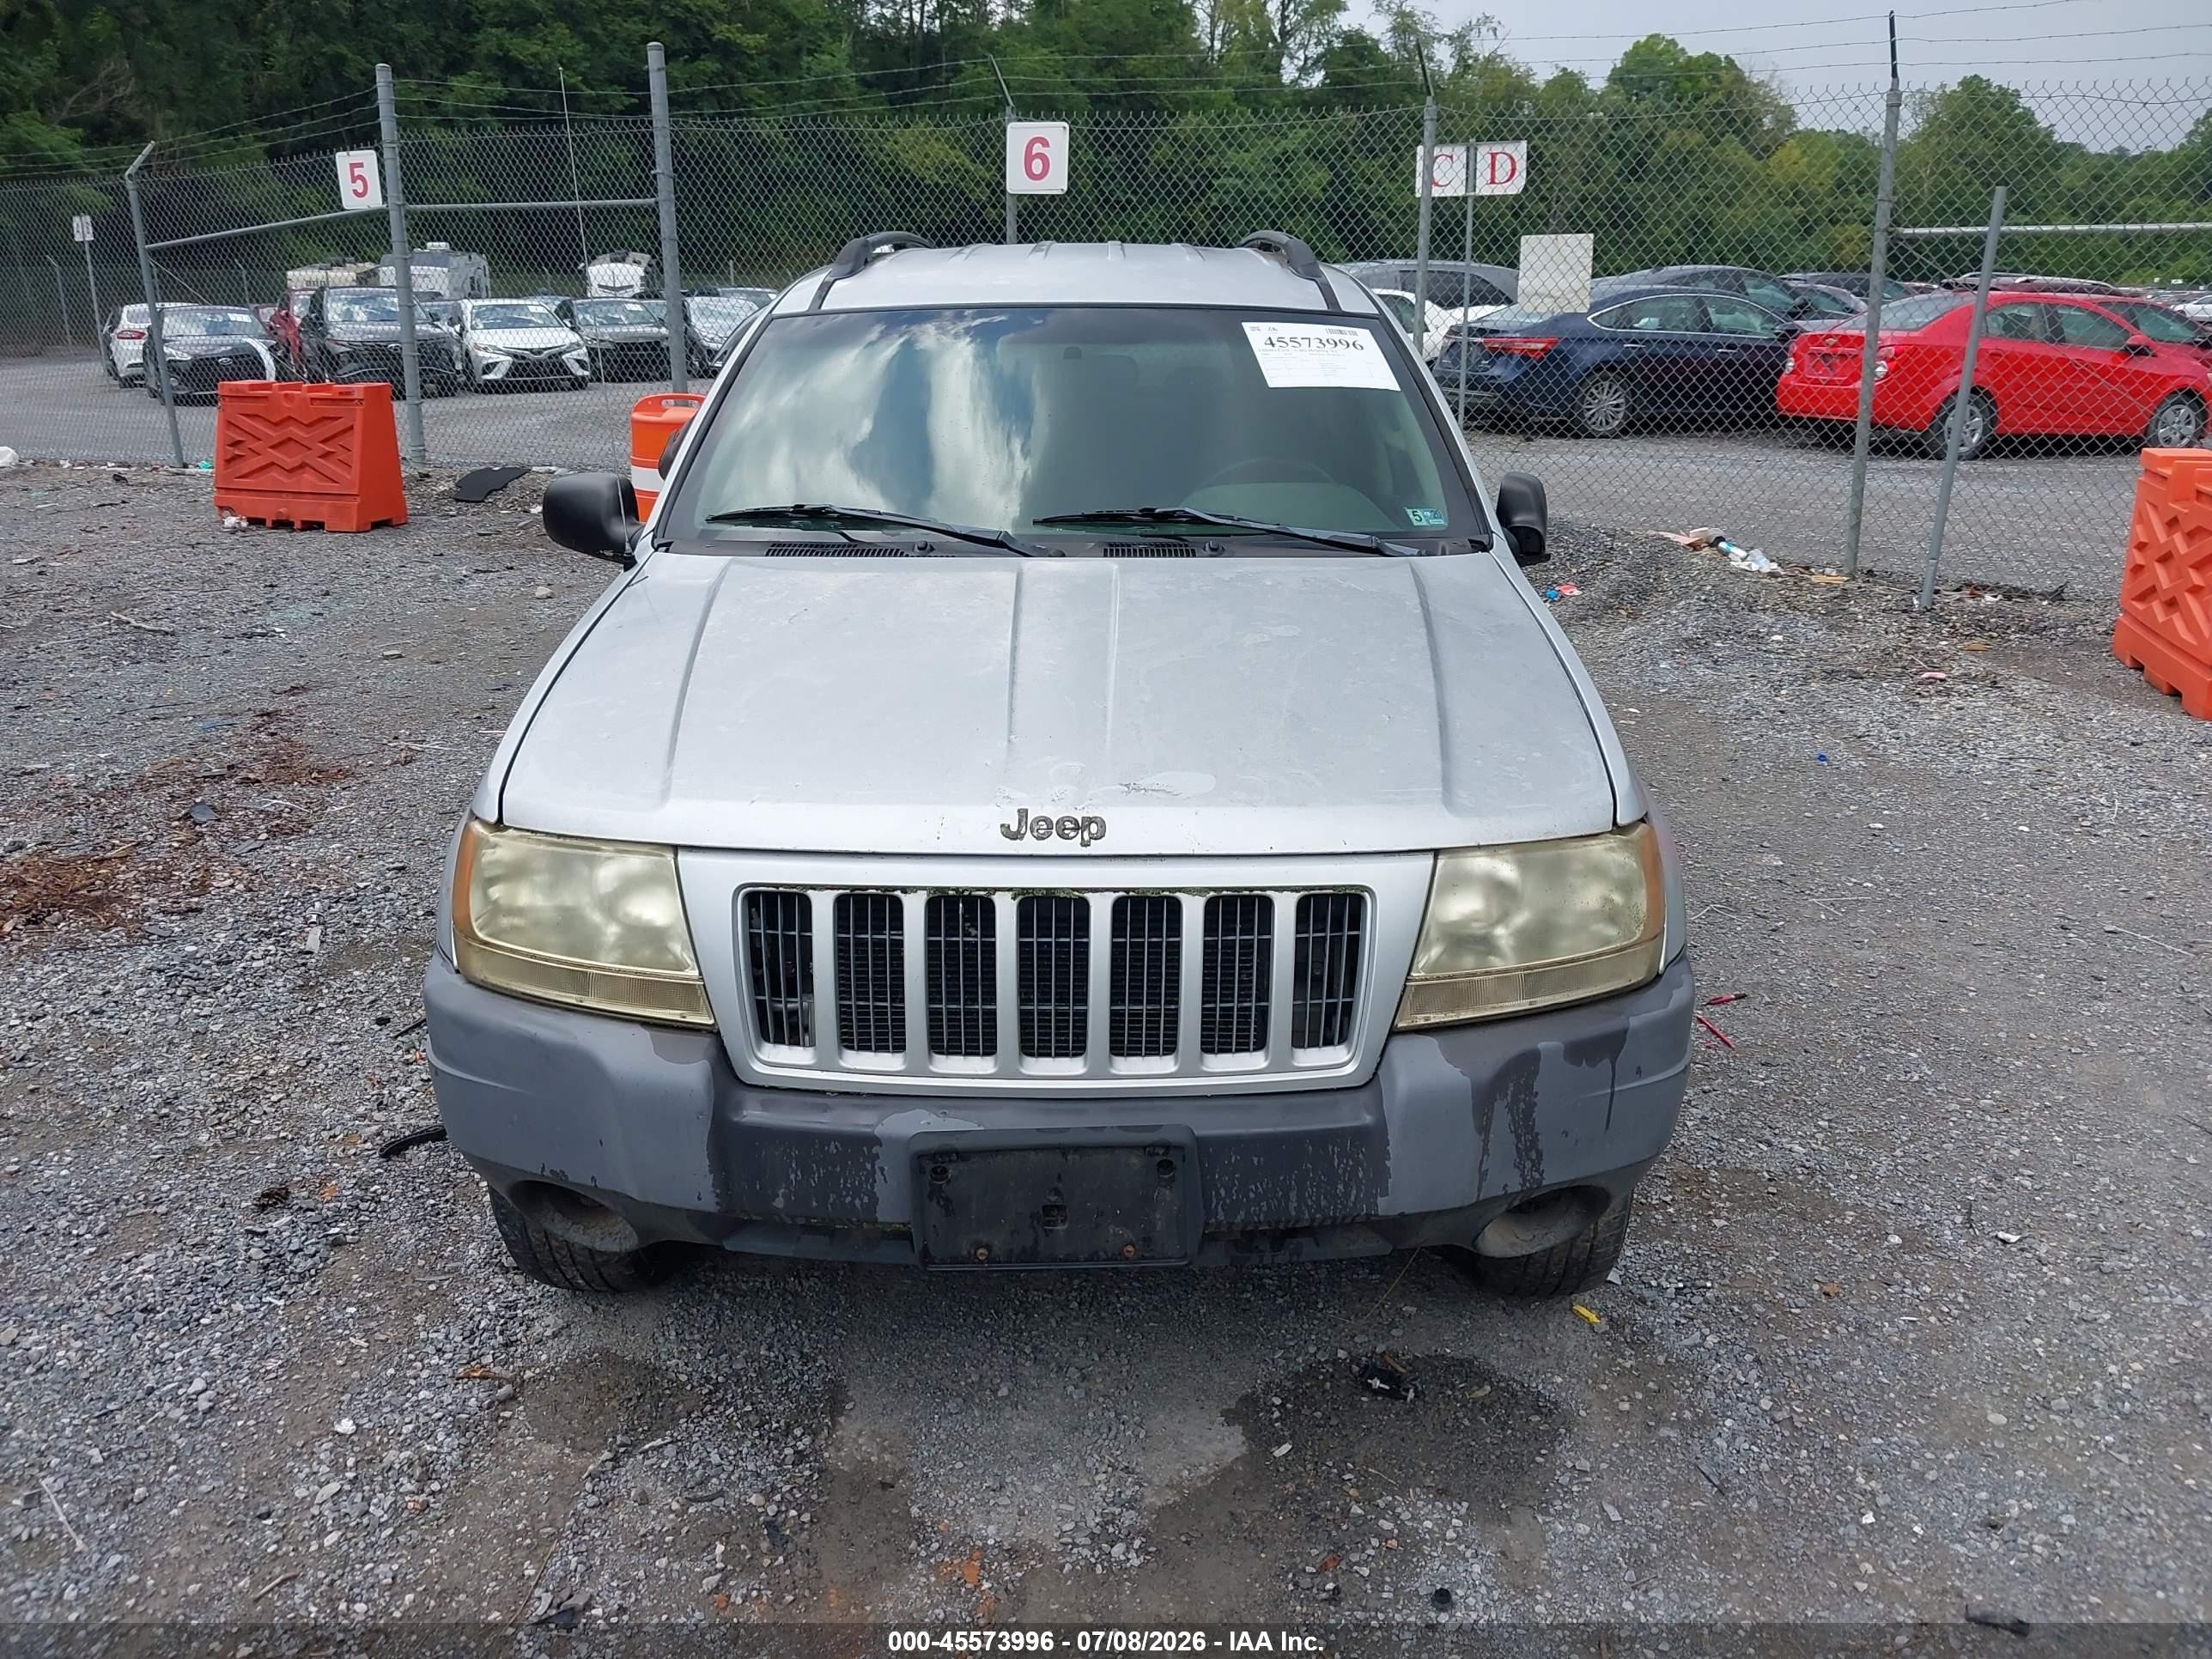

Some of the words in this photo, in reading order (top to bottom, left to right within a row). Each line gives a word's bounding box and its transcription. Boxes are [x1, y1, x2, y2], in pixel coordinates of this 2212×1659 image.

[1024, 136, 1050, 181] 6
[1431, 153, 1455, 187] C
[1486, 151, 1517, 185] D
[349, 161, 369, 198] 5
[1264, 336, 1364, 351] 45573996
[1412, 510, 1423, 522] 5
[1000, 808, 1107, 848] Jeep
